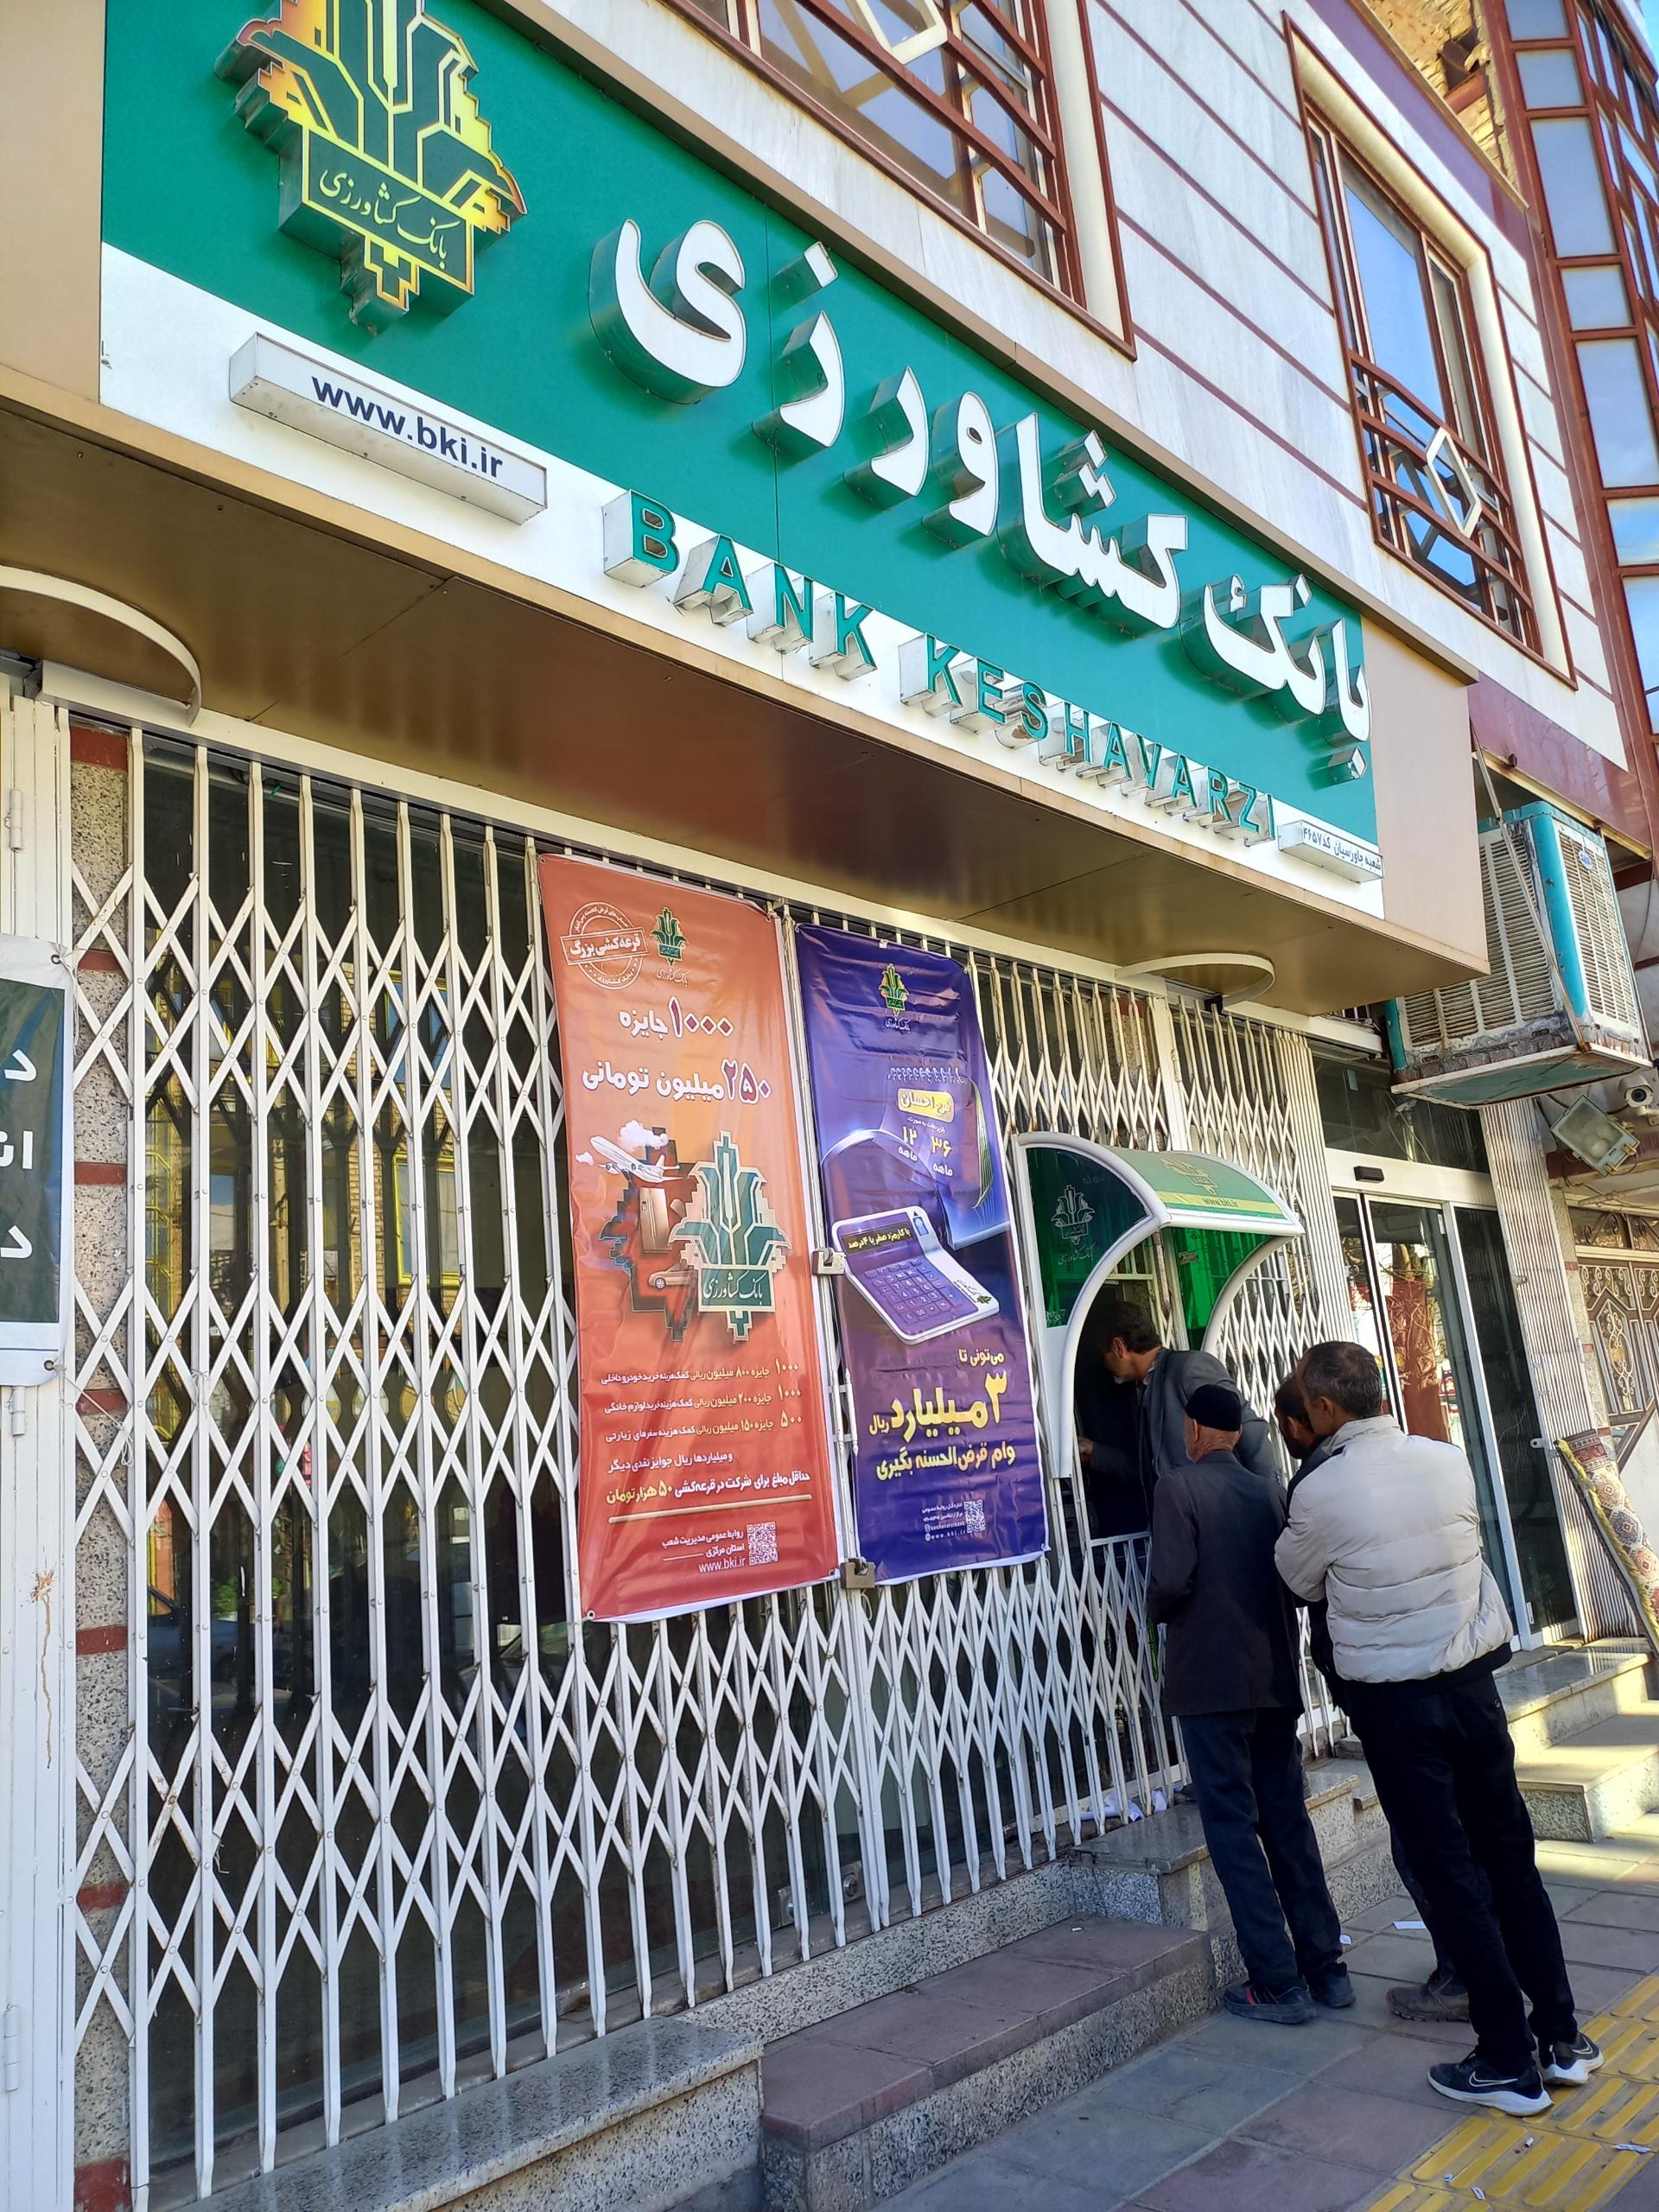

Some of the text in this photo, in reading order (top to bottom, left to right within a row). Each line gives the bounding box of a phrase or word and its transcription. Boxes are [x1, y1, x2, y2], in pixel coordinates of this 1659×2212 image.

[320, 168, 461, 270] بانک کشاورزی
[311, 375, 503, 478] www.bki.ir
[613, 219, 1189, 631] کشاورزی
[631, 490, 1276, 841] BANK KESHAVARZI
[569, 938, 596, 959] بزرگ
[619, 995, 734, 1039] ۱۰۰۰ جایزه
[582, 1058, 772, 1104] ۲۵۰ میلیون تومانی
[900, 1091, 935, 1109] احسان
[903, 1126, 918, 1146] ۱۲
[899, 1146, 918, 1162] ماهه
[933, 1162, 953, 1177] ماهه
[702, 1269, 767, 1306] بانک کشاورزی
[958, 1348, 968, 1363] تا
[706, 1367, 734, 1381] میلیون
[751, 1366, 770, 1379] جایزه
[775, 1357, 798, 1375] ۱۰۰۰
[753, 1392, 772, 1405] جایزه
[778, 1382, 802, 1401] ۱۰۰۰
[710, 1394, 737, 1408] میلیون
[890, 1387, 989, 1443] میلیارد
[712, 1421, 739, 1434] میلیون
[754, 1418, 774, 1432] جایزه
[869, 1414, 889, 1435] ریال
[674, 1453, 693, 1467] ریال
[876, 1446, 913, 1481] بگیری
[991, 1440, 1016, 1469] وام
[607, 1458, 631, 1474] دیگر
[725, 1473, 752, 1491] شرکت
[753, 1473, 770, 1491] برای
[772, 1471, 788, 1489] مبلغ
[789, 1470, 810, 1486] حداقل
[606, 1487, 636, 1505] تومان
[635, 1485, 658, 1503] هزار
[698, 1555, 746, 1573] www.bki.ir
